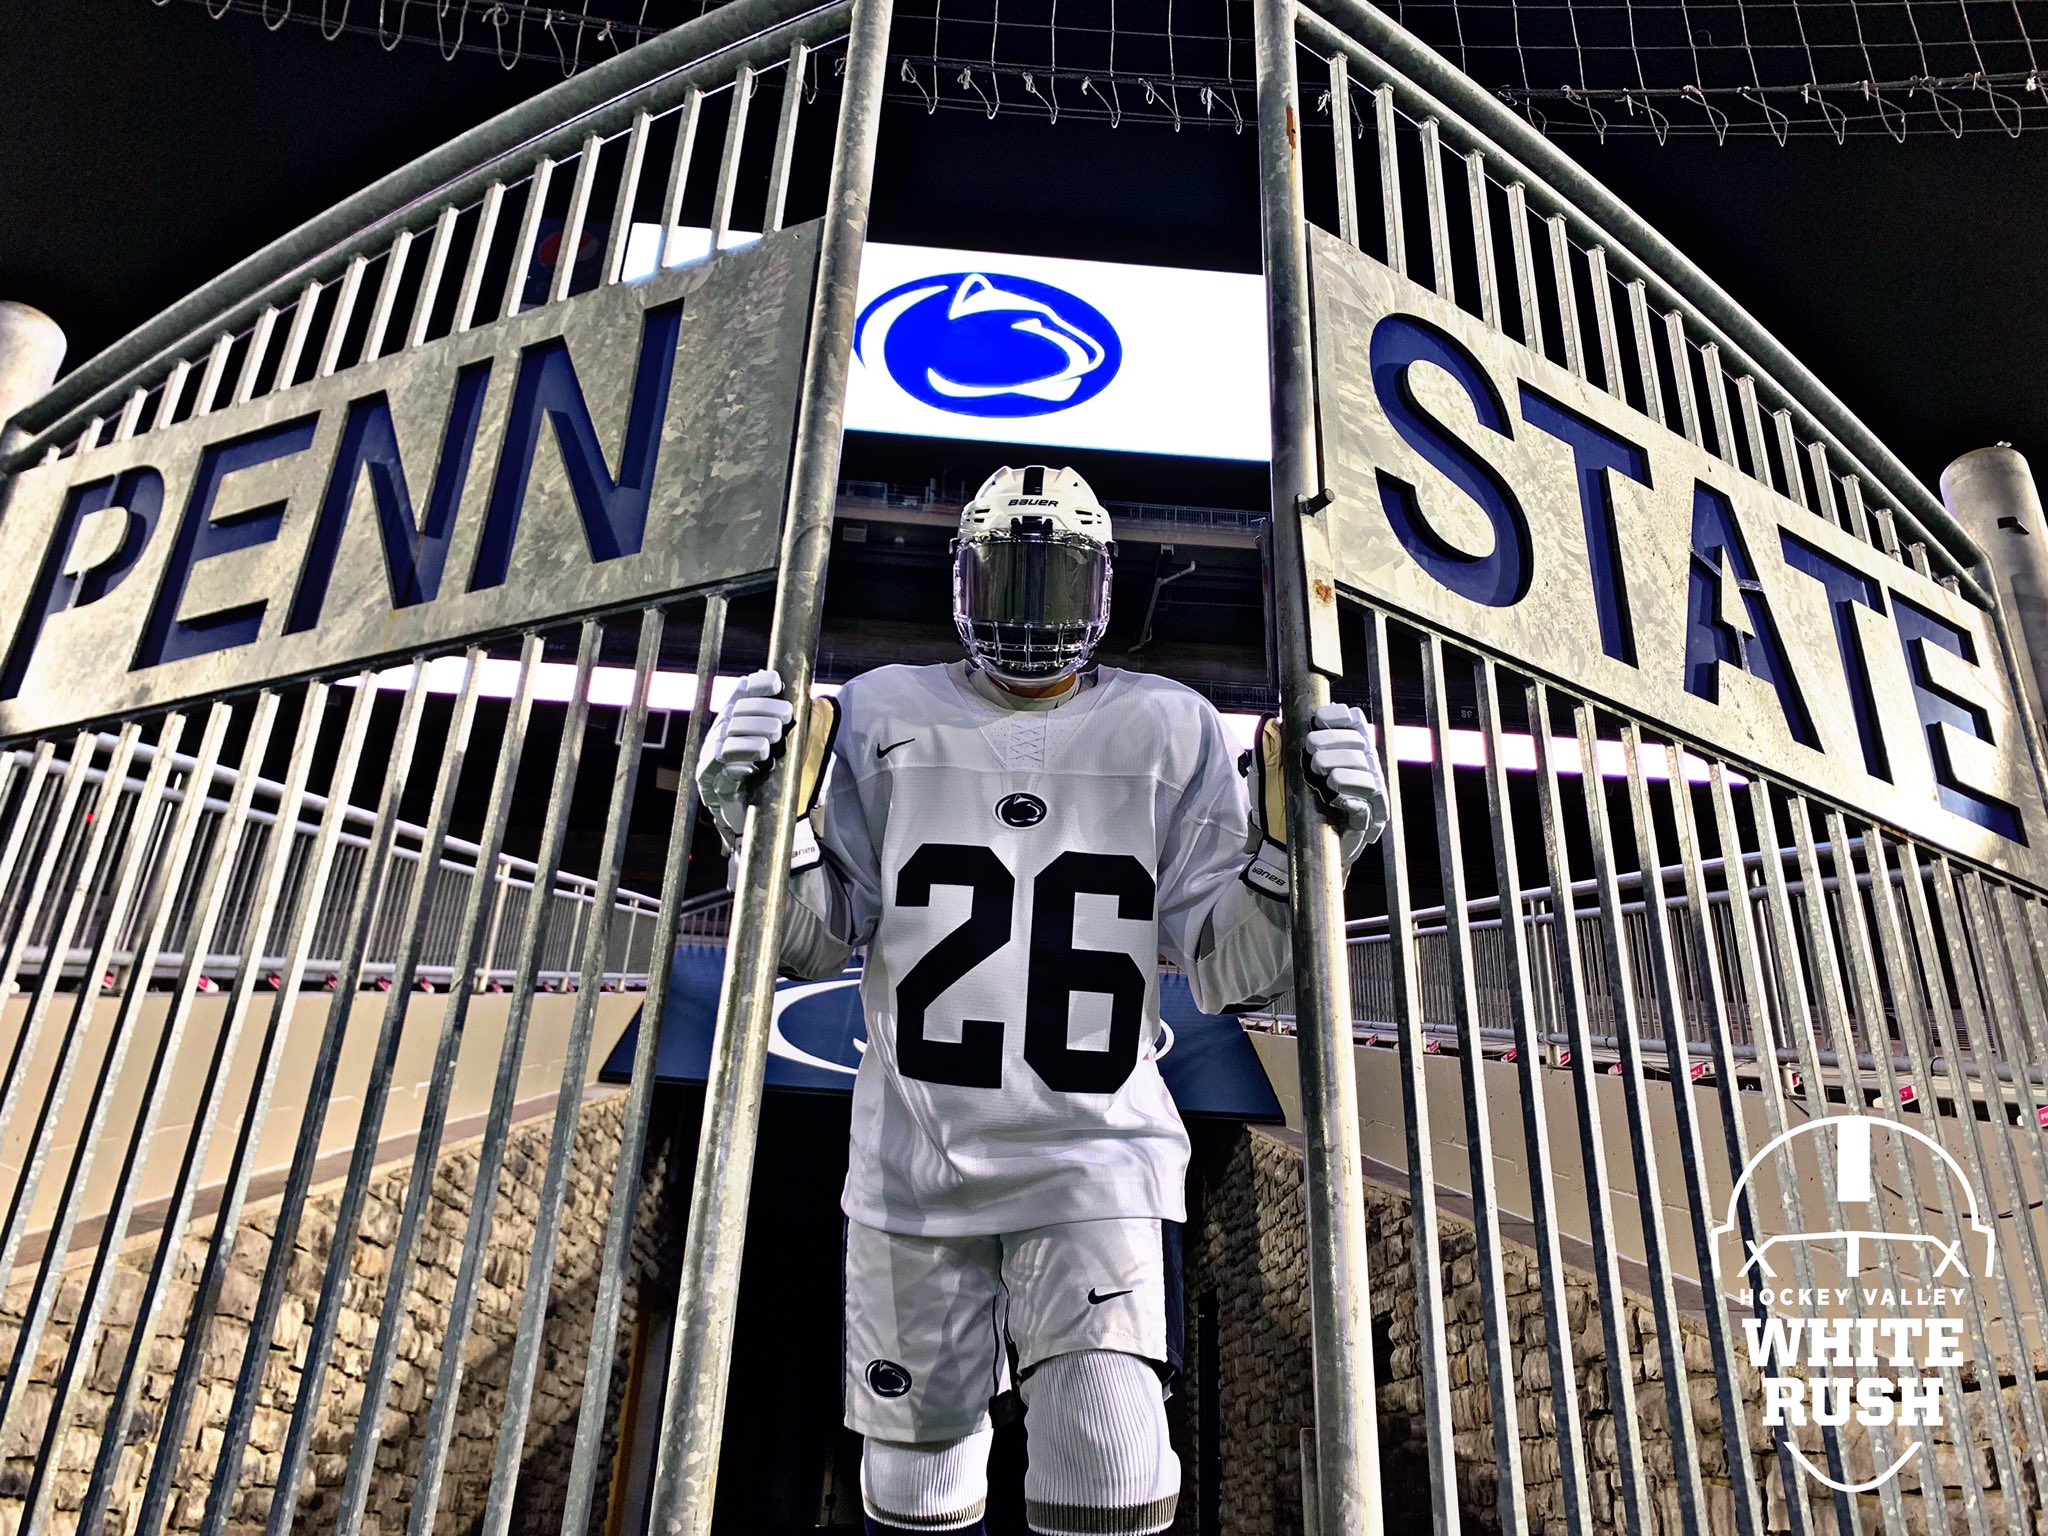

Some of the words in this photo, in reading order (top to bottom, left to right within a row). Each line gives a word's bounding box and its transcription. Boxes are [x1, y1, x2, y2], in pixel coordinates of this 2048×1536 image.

[1, 299, 684, 700] PENN
[1008, 498, 1059, 508] BAUER
[1369, 313, 2029, 846] STATE
[791, 846, 816, 859] BAUE
[1251, 866, 1286, 887] BAUER
[895, 843, 1155, 1094] 26
